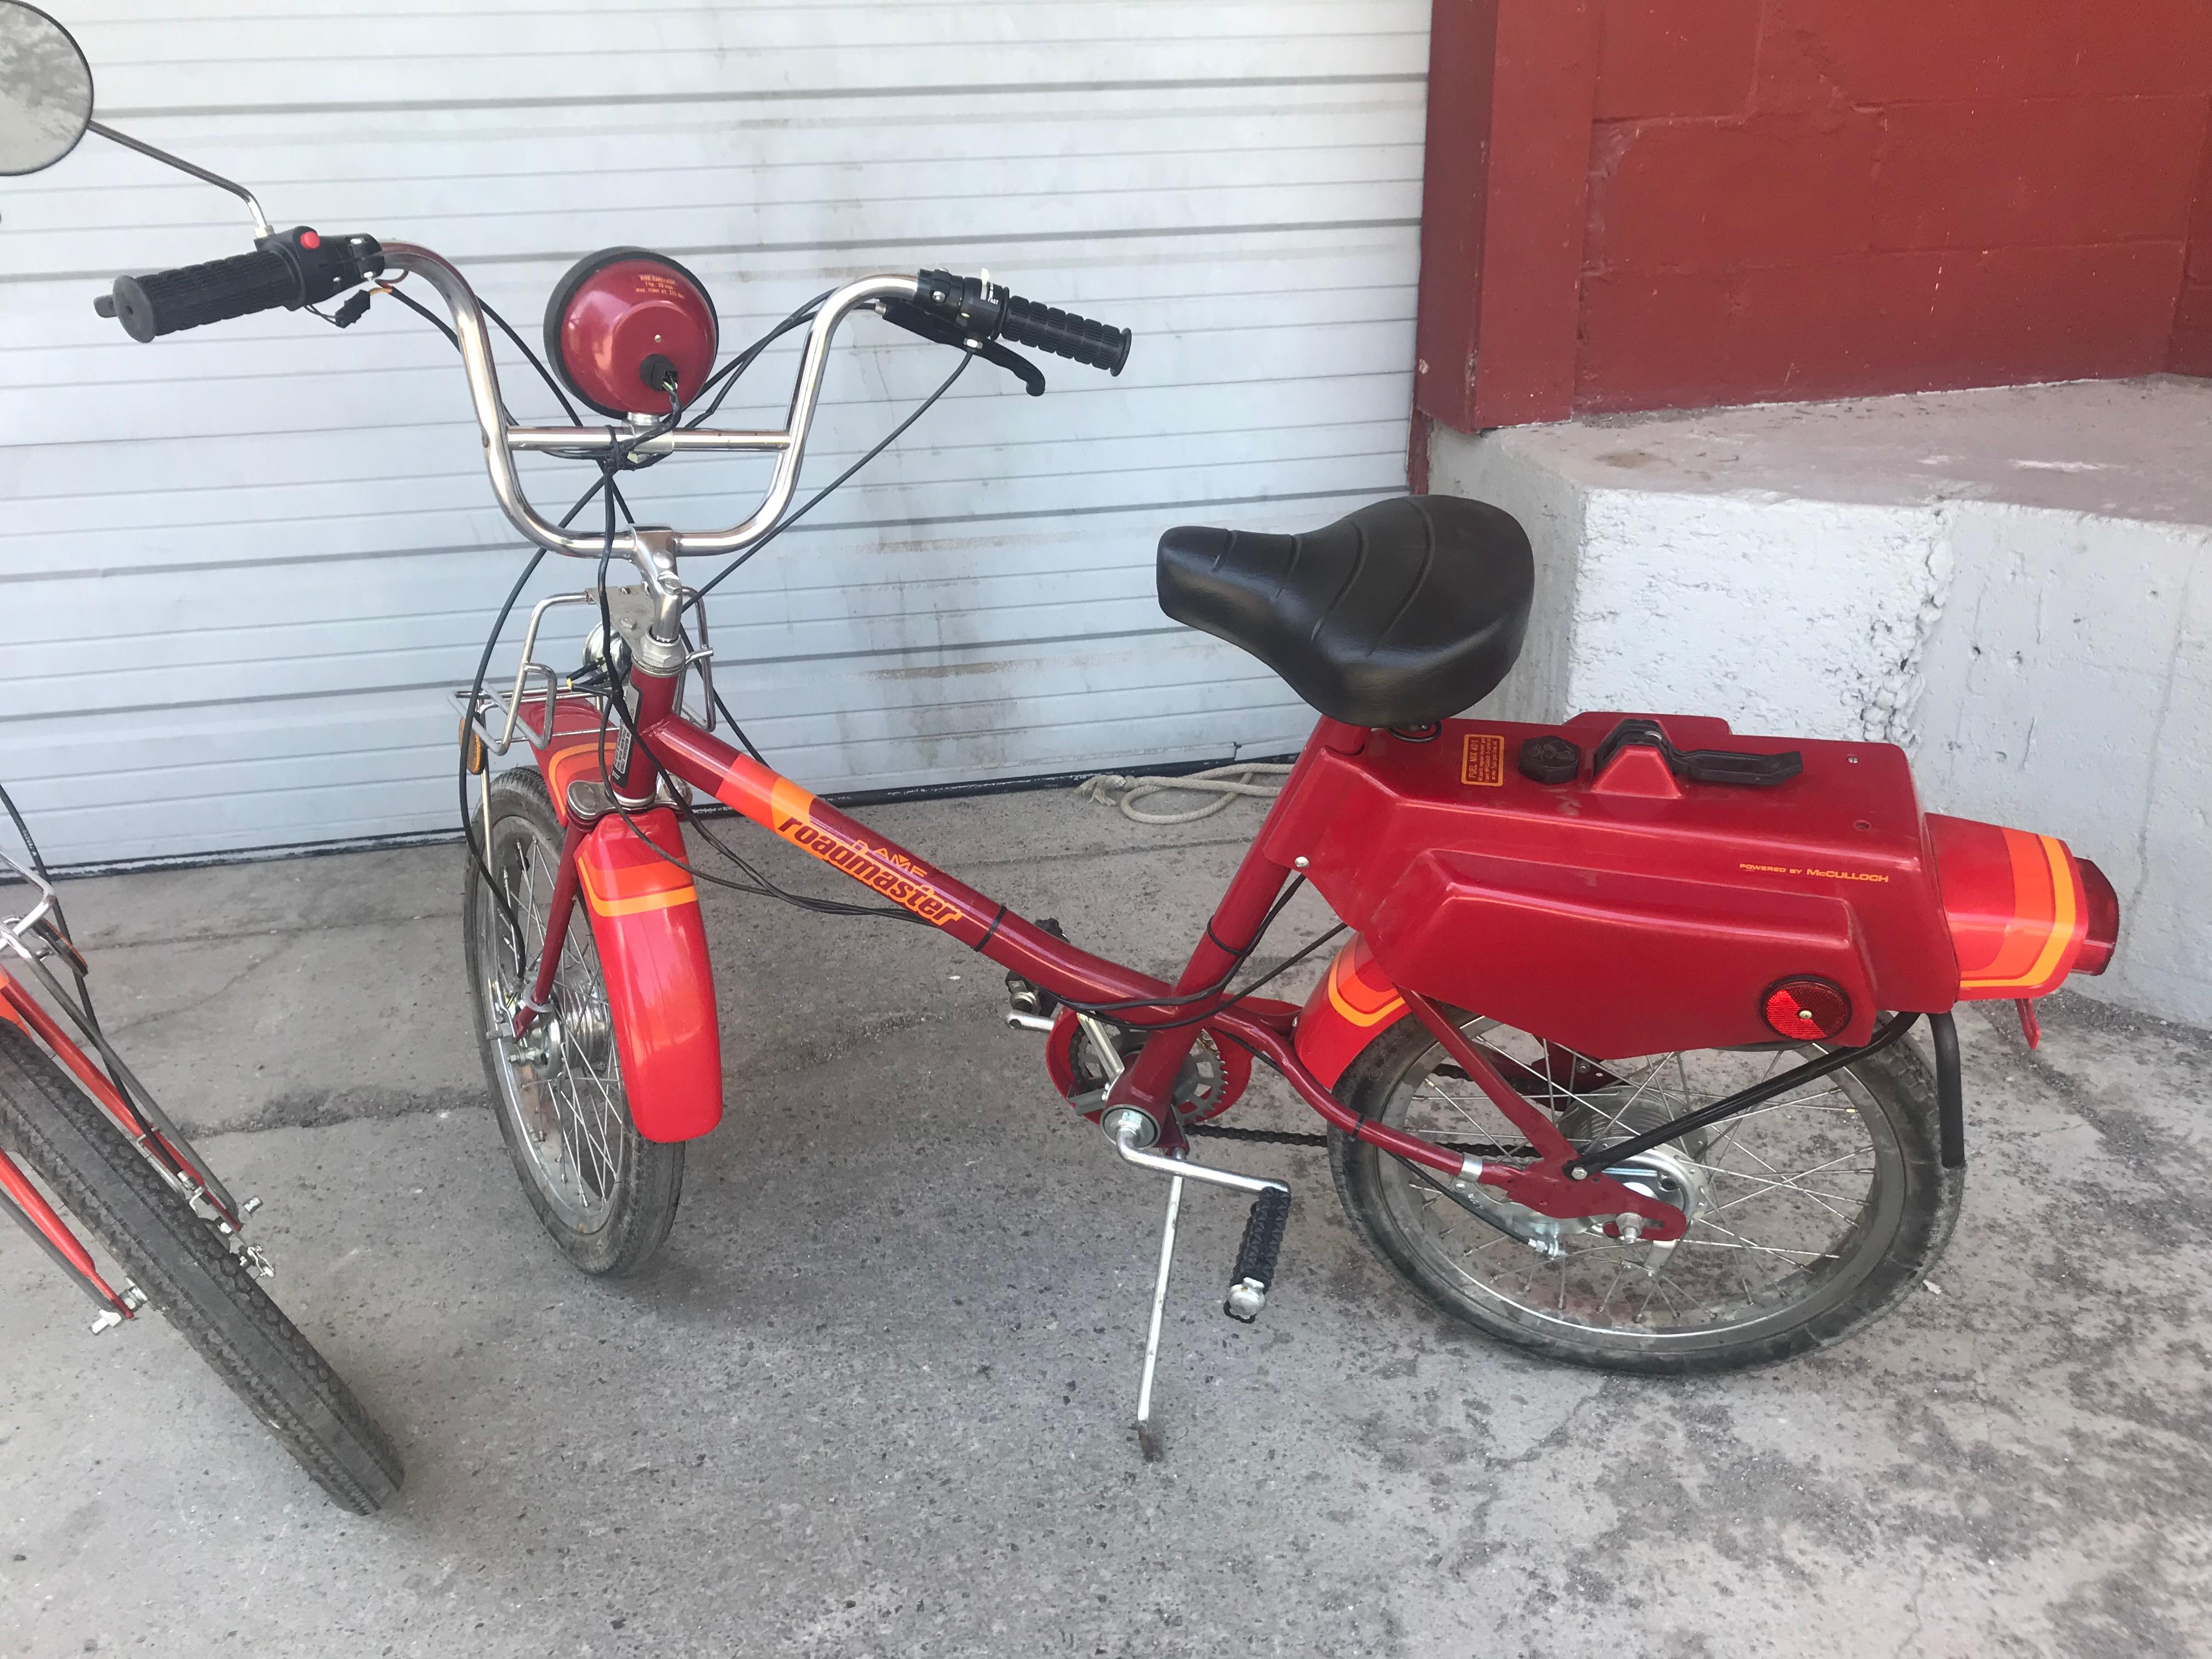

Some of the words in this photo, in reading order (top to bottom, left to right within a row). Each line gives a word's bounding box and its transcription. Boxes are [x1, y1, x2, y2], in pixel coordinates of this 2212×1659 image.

[988, 297, 999, 305] FAST
[1469, 764, 1477, 778] FUEL
[777, 816, 961, 925] roadmaster
[874, 848, 927, 877] AMF
[1740, 863, 1786, 873] POWERED
[1807, 868, 1888, 883] McCULLOCH
